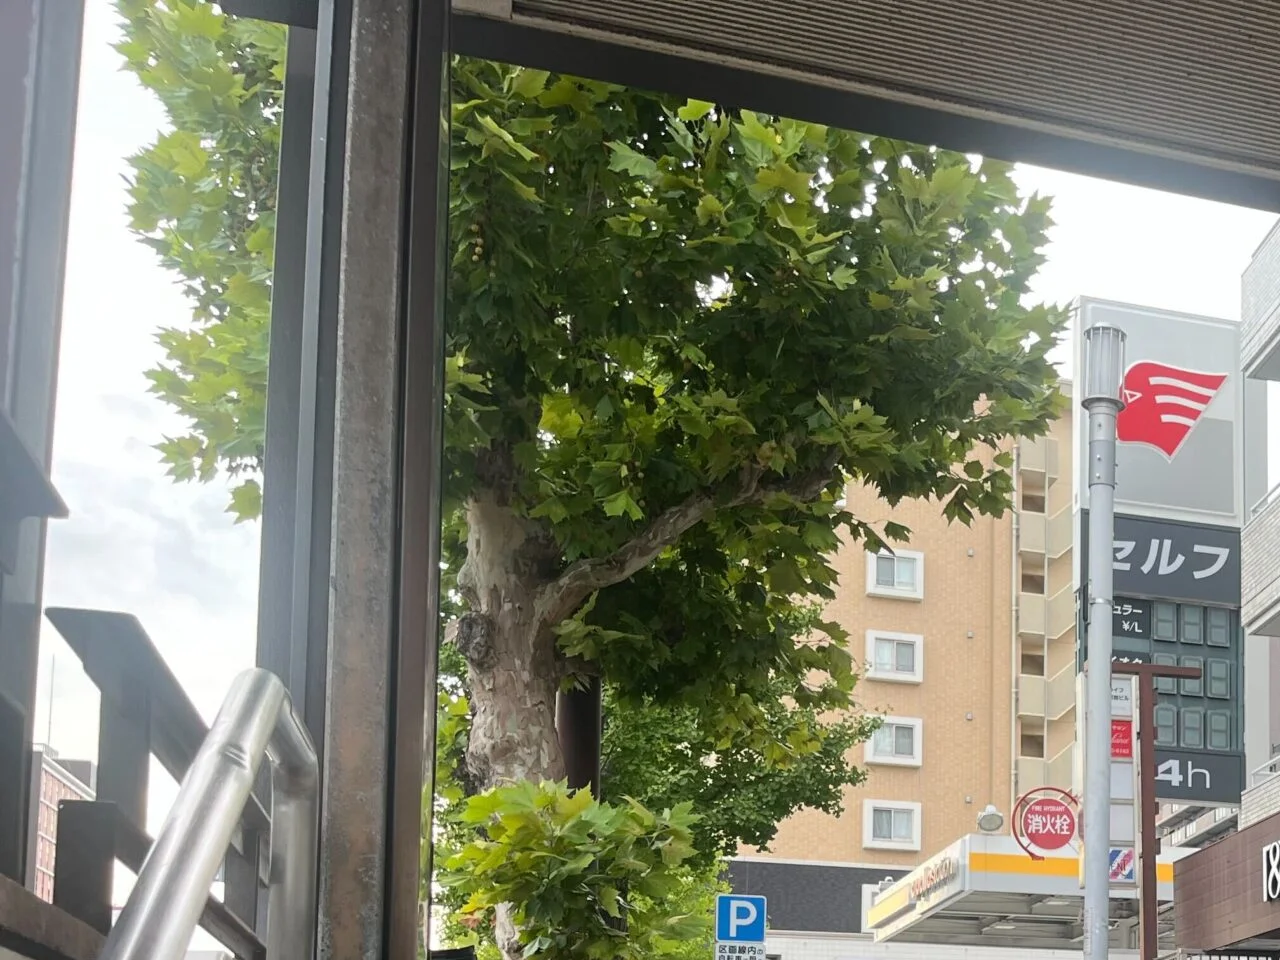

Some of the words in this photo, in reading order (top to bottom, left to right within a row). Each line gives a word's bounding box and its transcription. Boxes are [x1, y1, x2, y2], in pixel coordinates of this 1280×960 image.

[1112, 539, 1230, 579] セルフ
[1154, 760, 1210, 789] 4h
[1027, 814, 1070, 835] 消火栓
[729, 900, 758, 938] P
